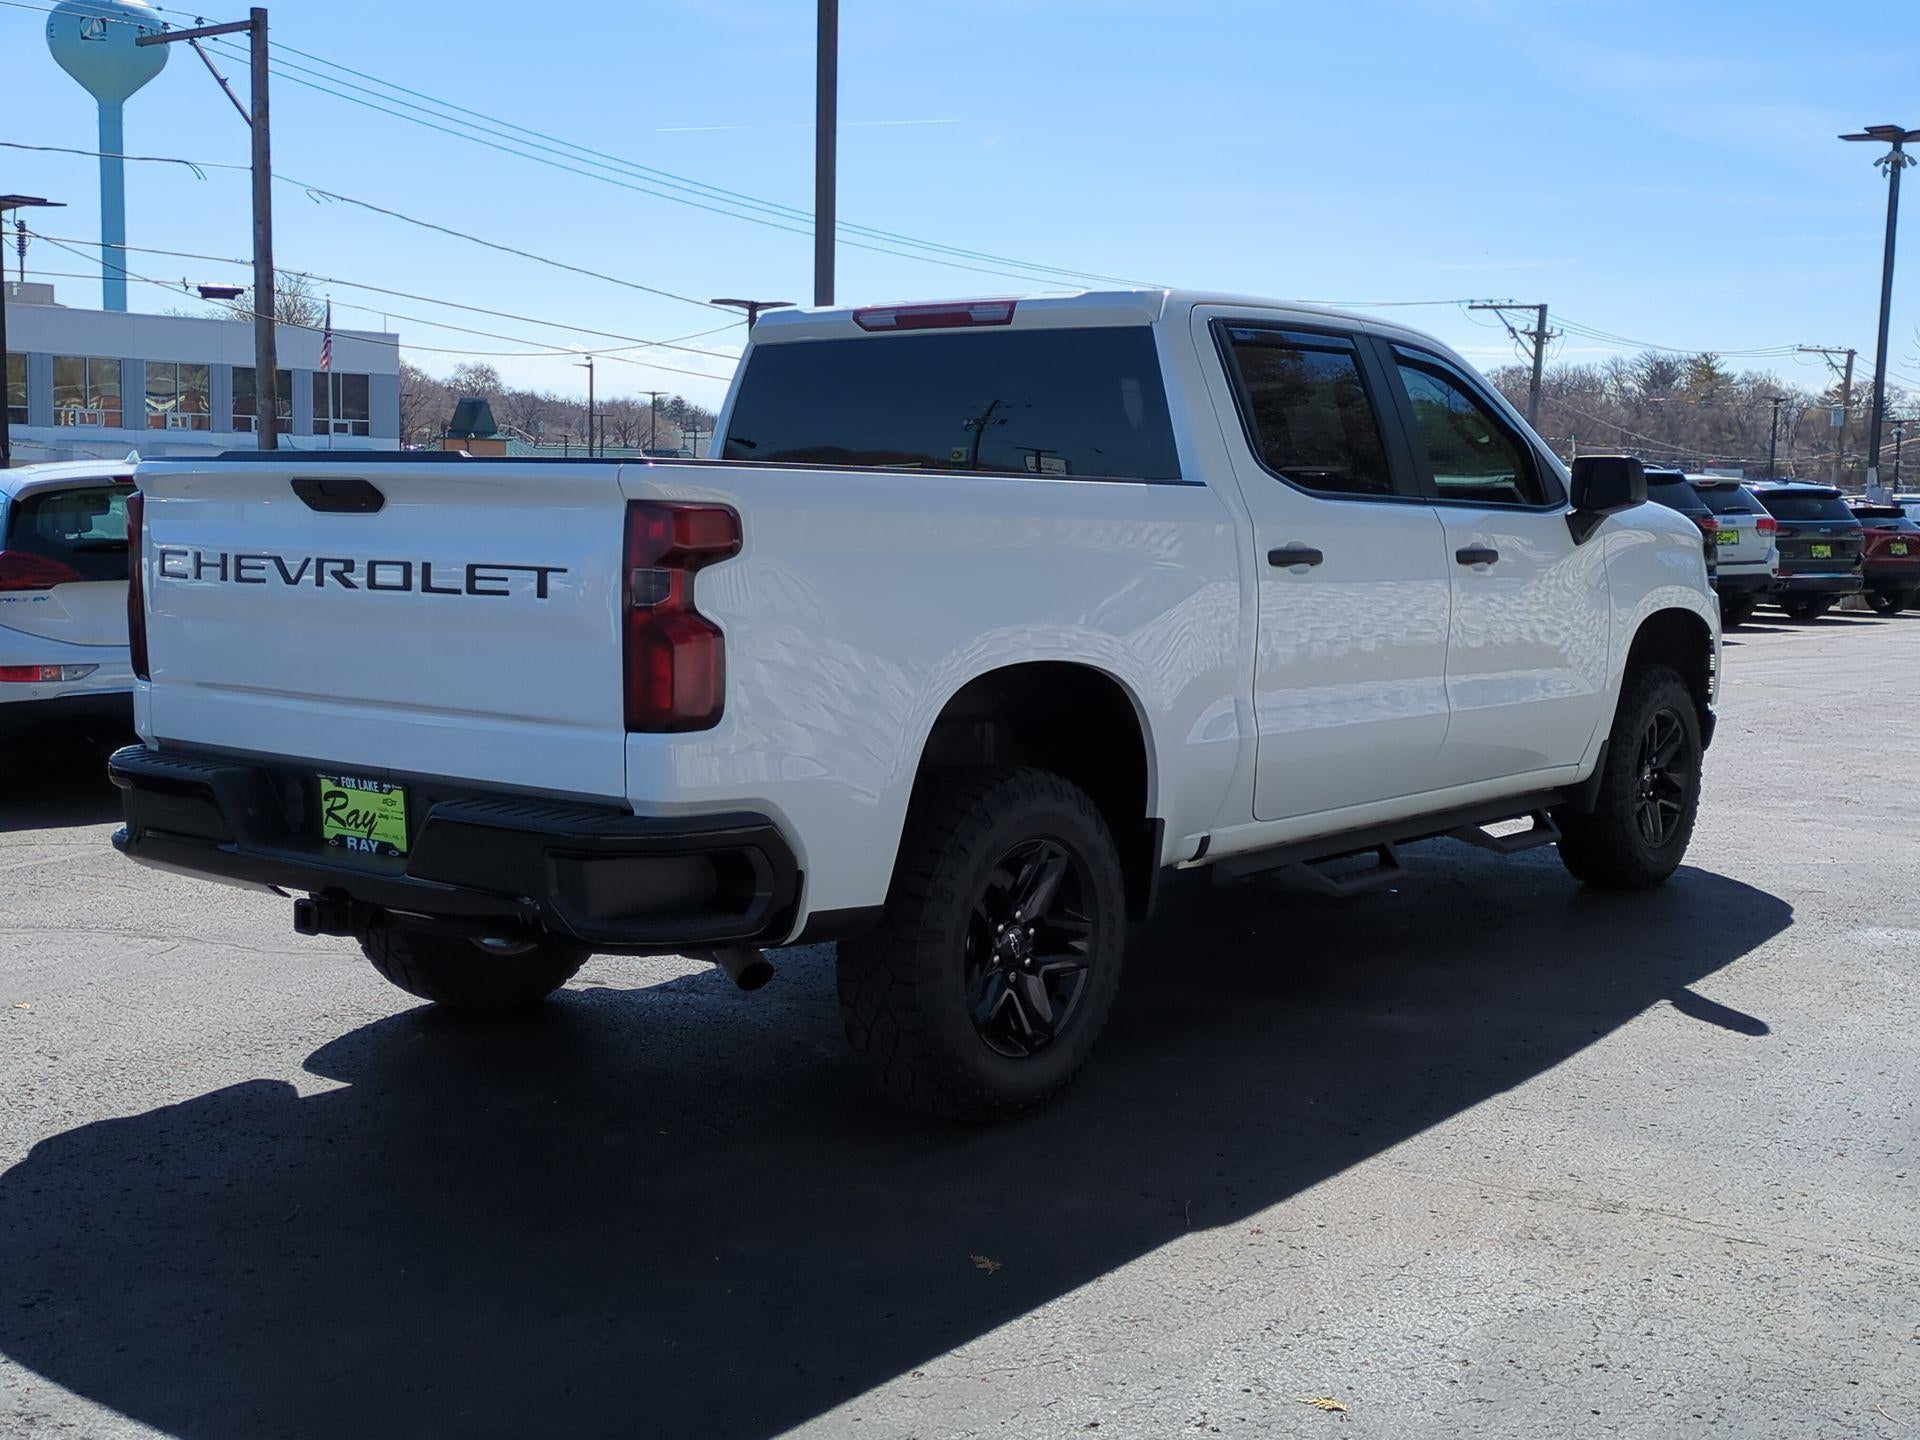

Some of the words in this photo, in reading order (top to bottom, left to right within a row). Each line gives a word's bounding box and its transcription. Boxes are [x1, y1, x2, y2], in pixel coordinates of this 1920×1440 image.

[159, 549, 568, 599] CHEVROLET
[341, 776, 357, 790] FOX
[358, 779, 380, 793] LAKE
[323, 790, 379, 839] Ray
[346, 836, 379, 853] RAY
